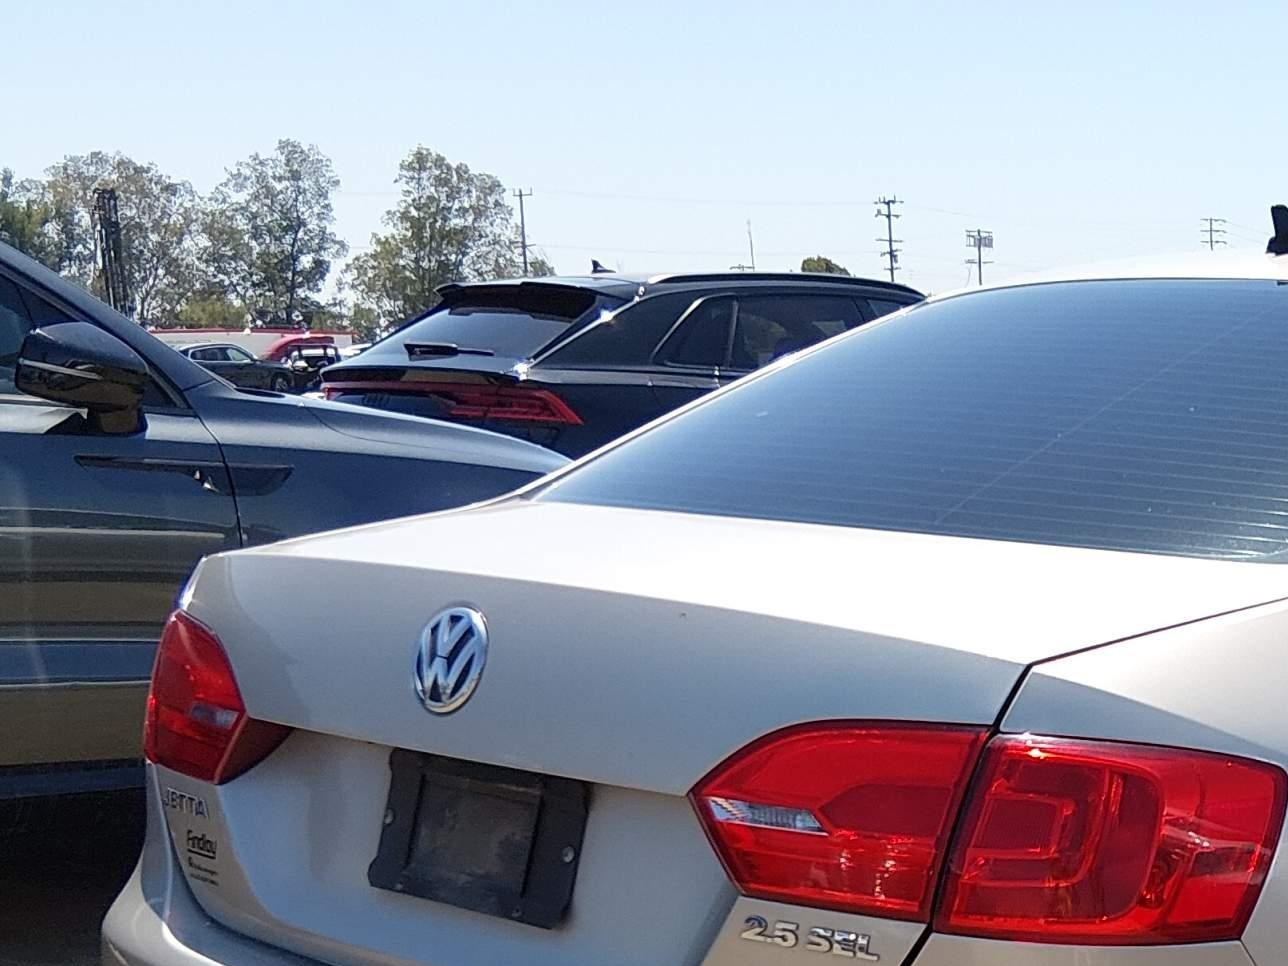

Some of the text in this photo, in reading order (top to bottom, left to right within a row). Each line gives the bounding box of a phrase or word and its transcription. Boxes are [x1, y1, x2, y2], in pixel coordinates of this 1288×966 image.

[162, 787, 209, 819] JETTA
[741, 915, 880, 961] 2.5 SEL
